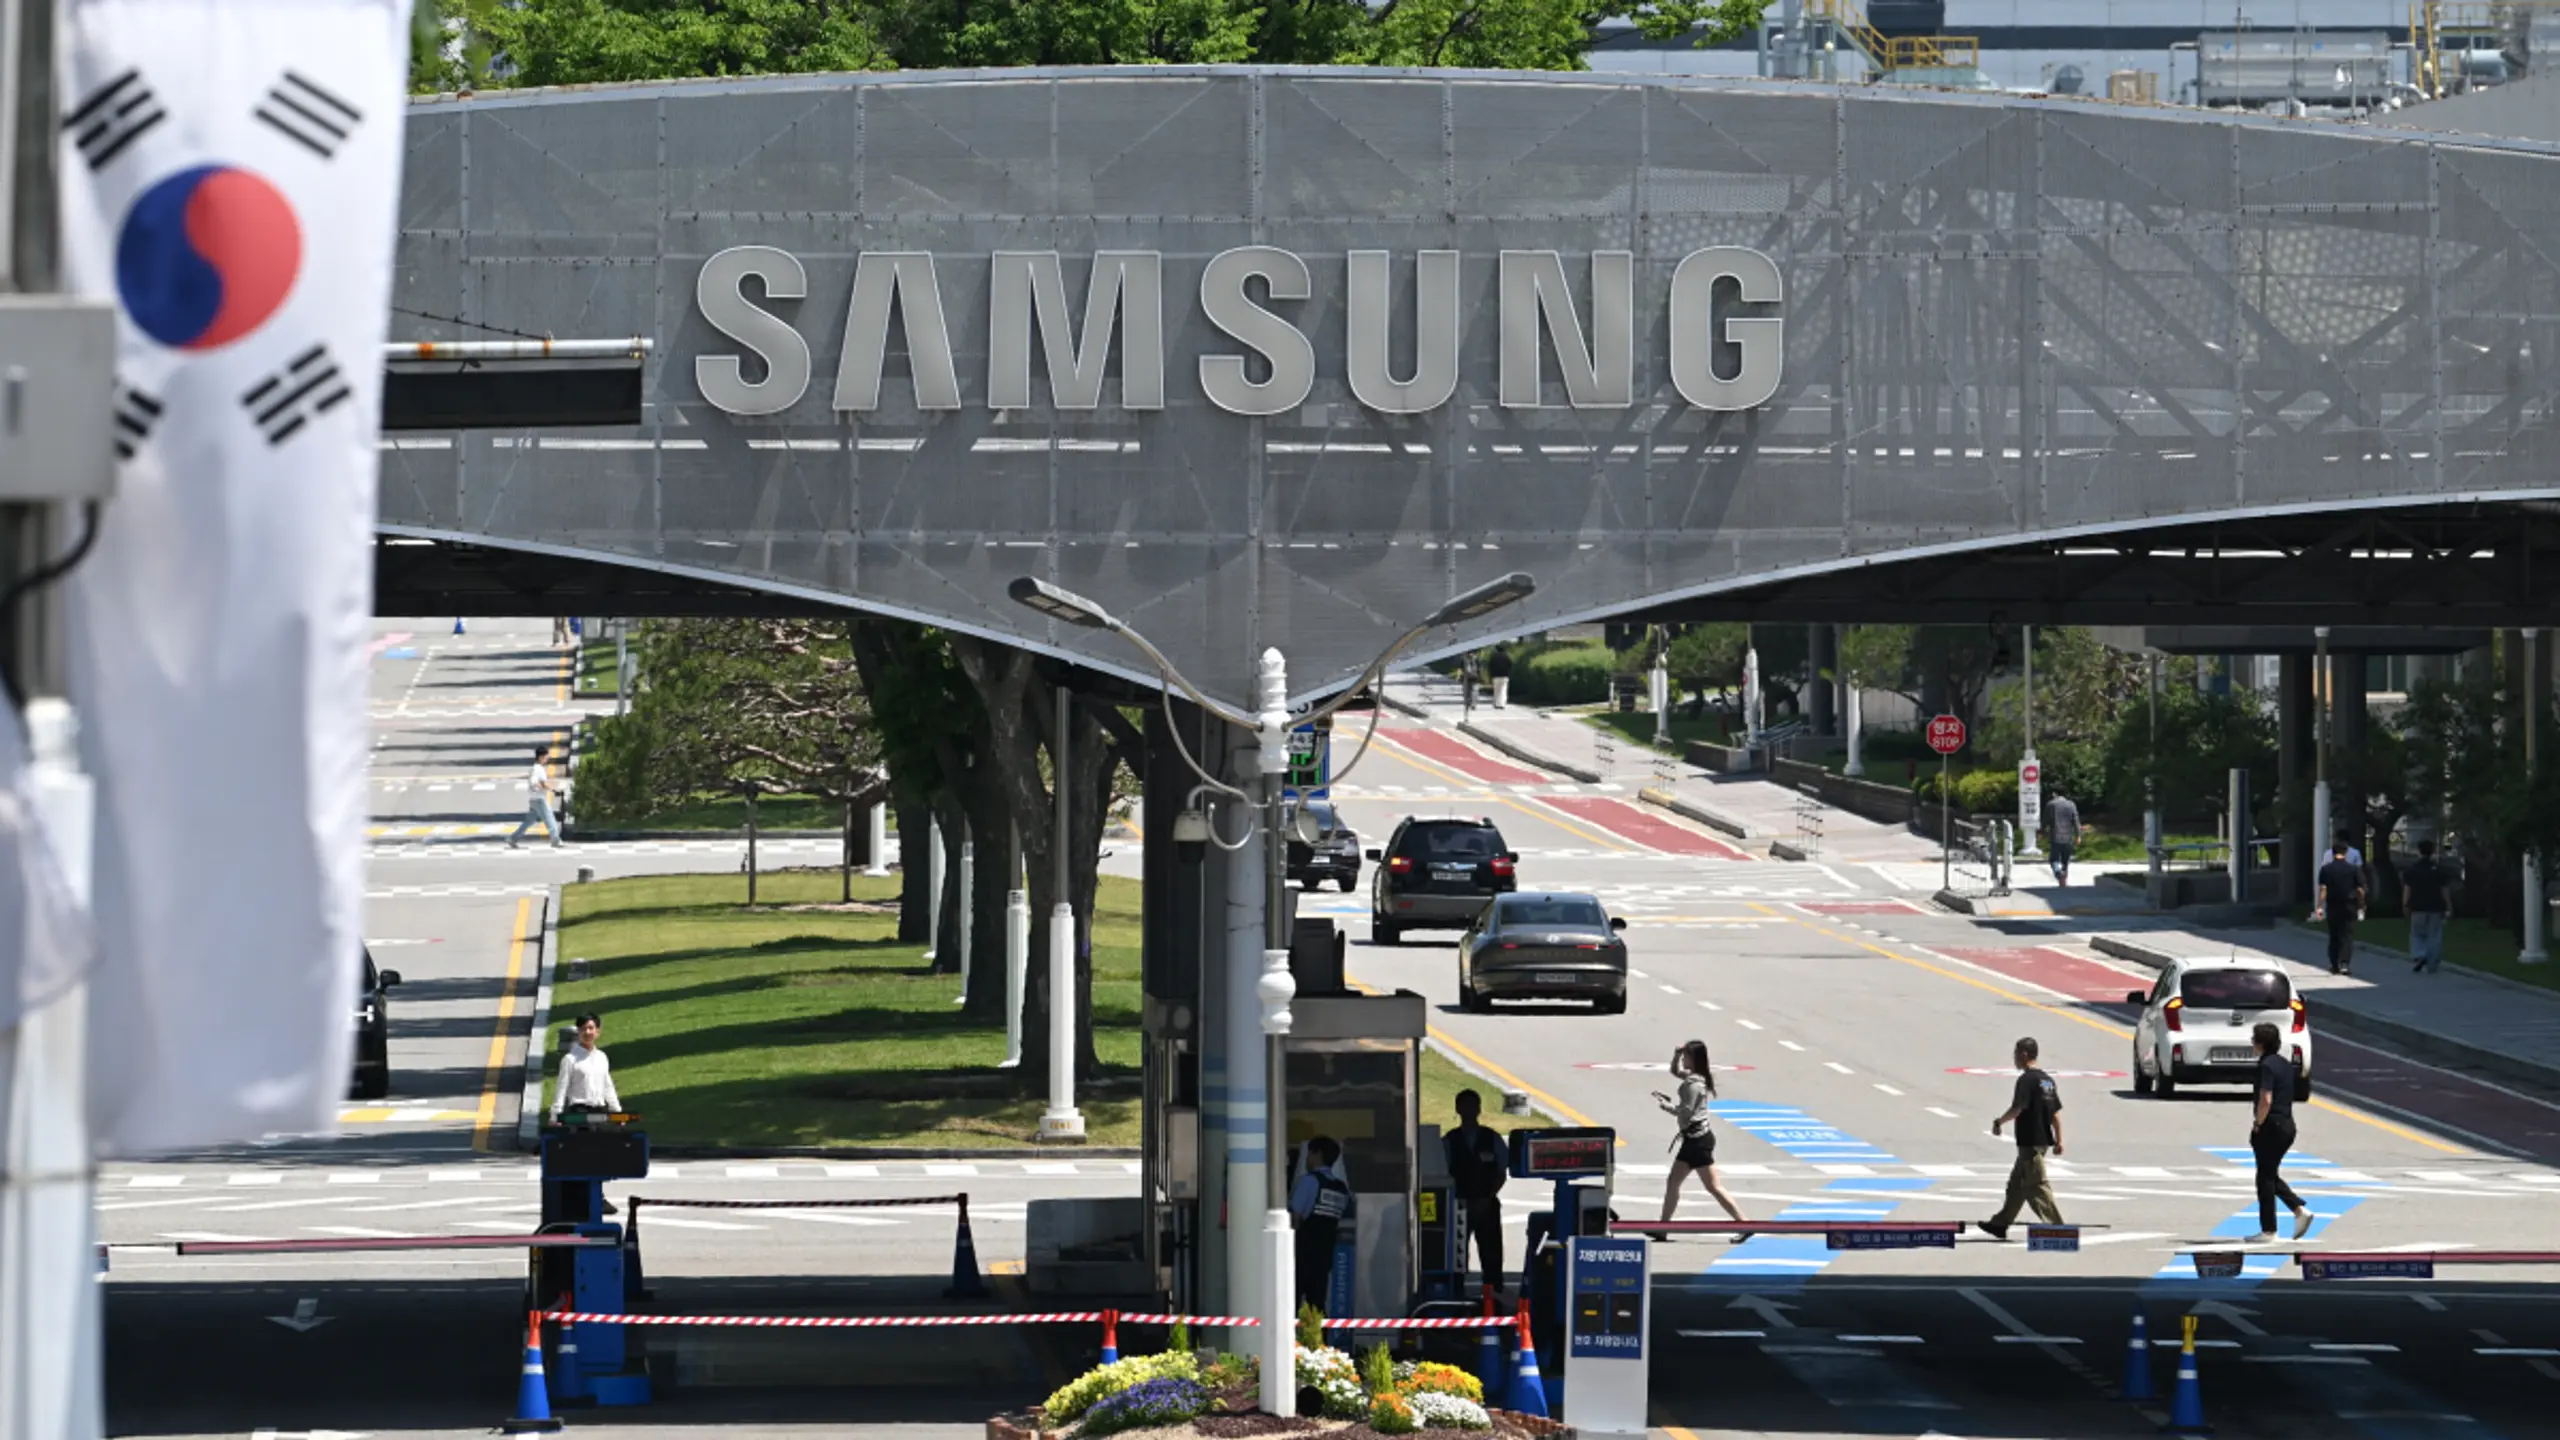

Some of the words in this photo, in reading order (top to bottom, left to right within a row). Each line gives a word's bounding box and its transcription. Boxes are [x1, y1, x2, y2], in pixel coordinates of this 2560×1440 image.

[694, 245, 1783, 415] SAMSUNG
[1934, 721, 1960, 735] 정지
[1932, 736, 1960, 748] STOP
